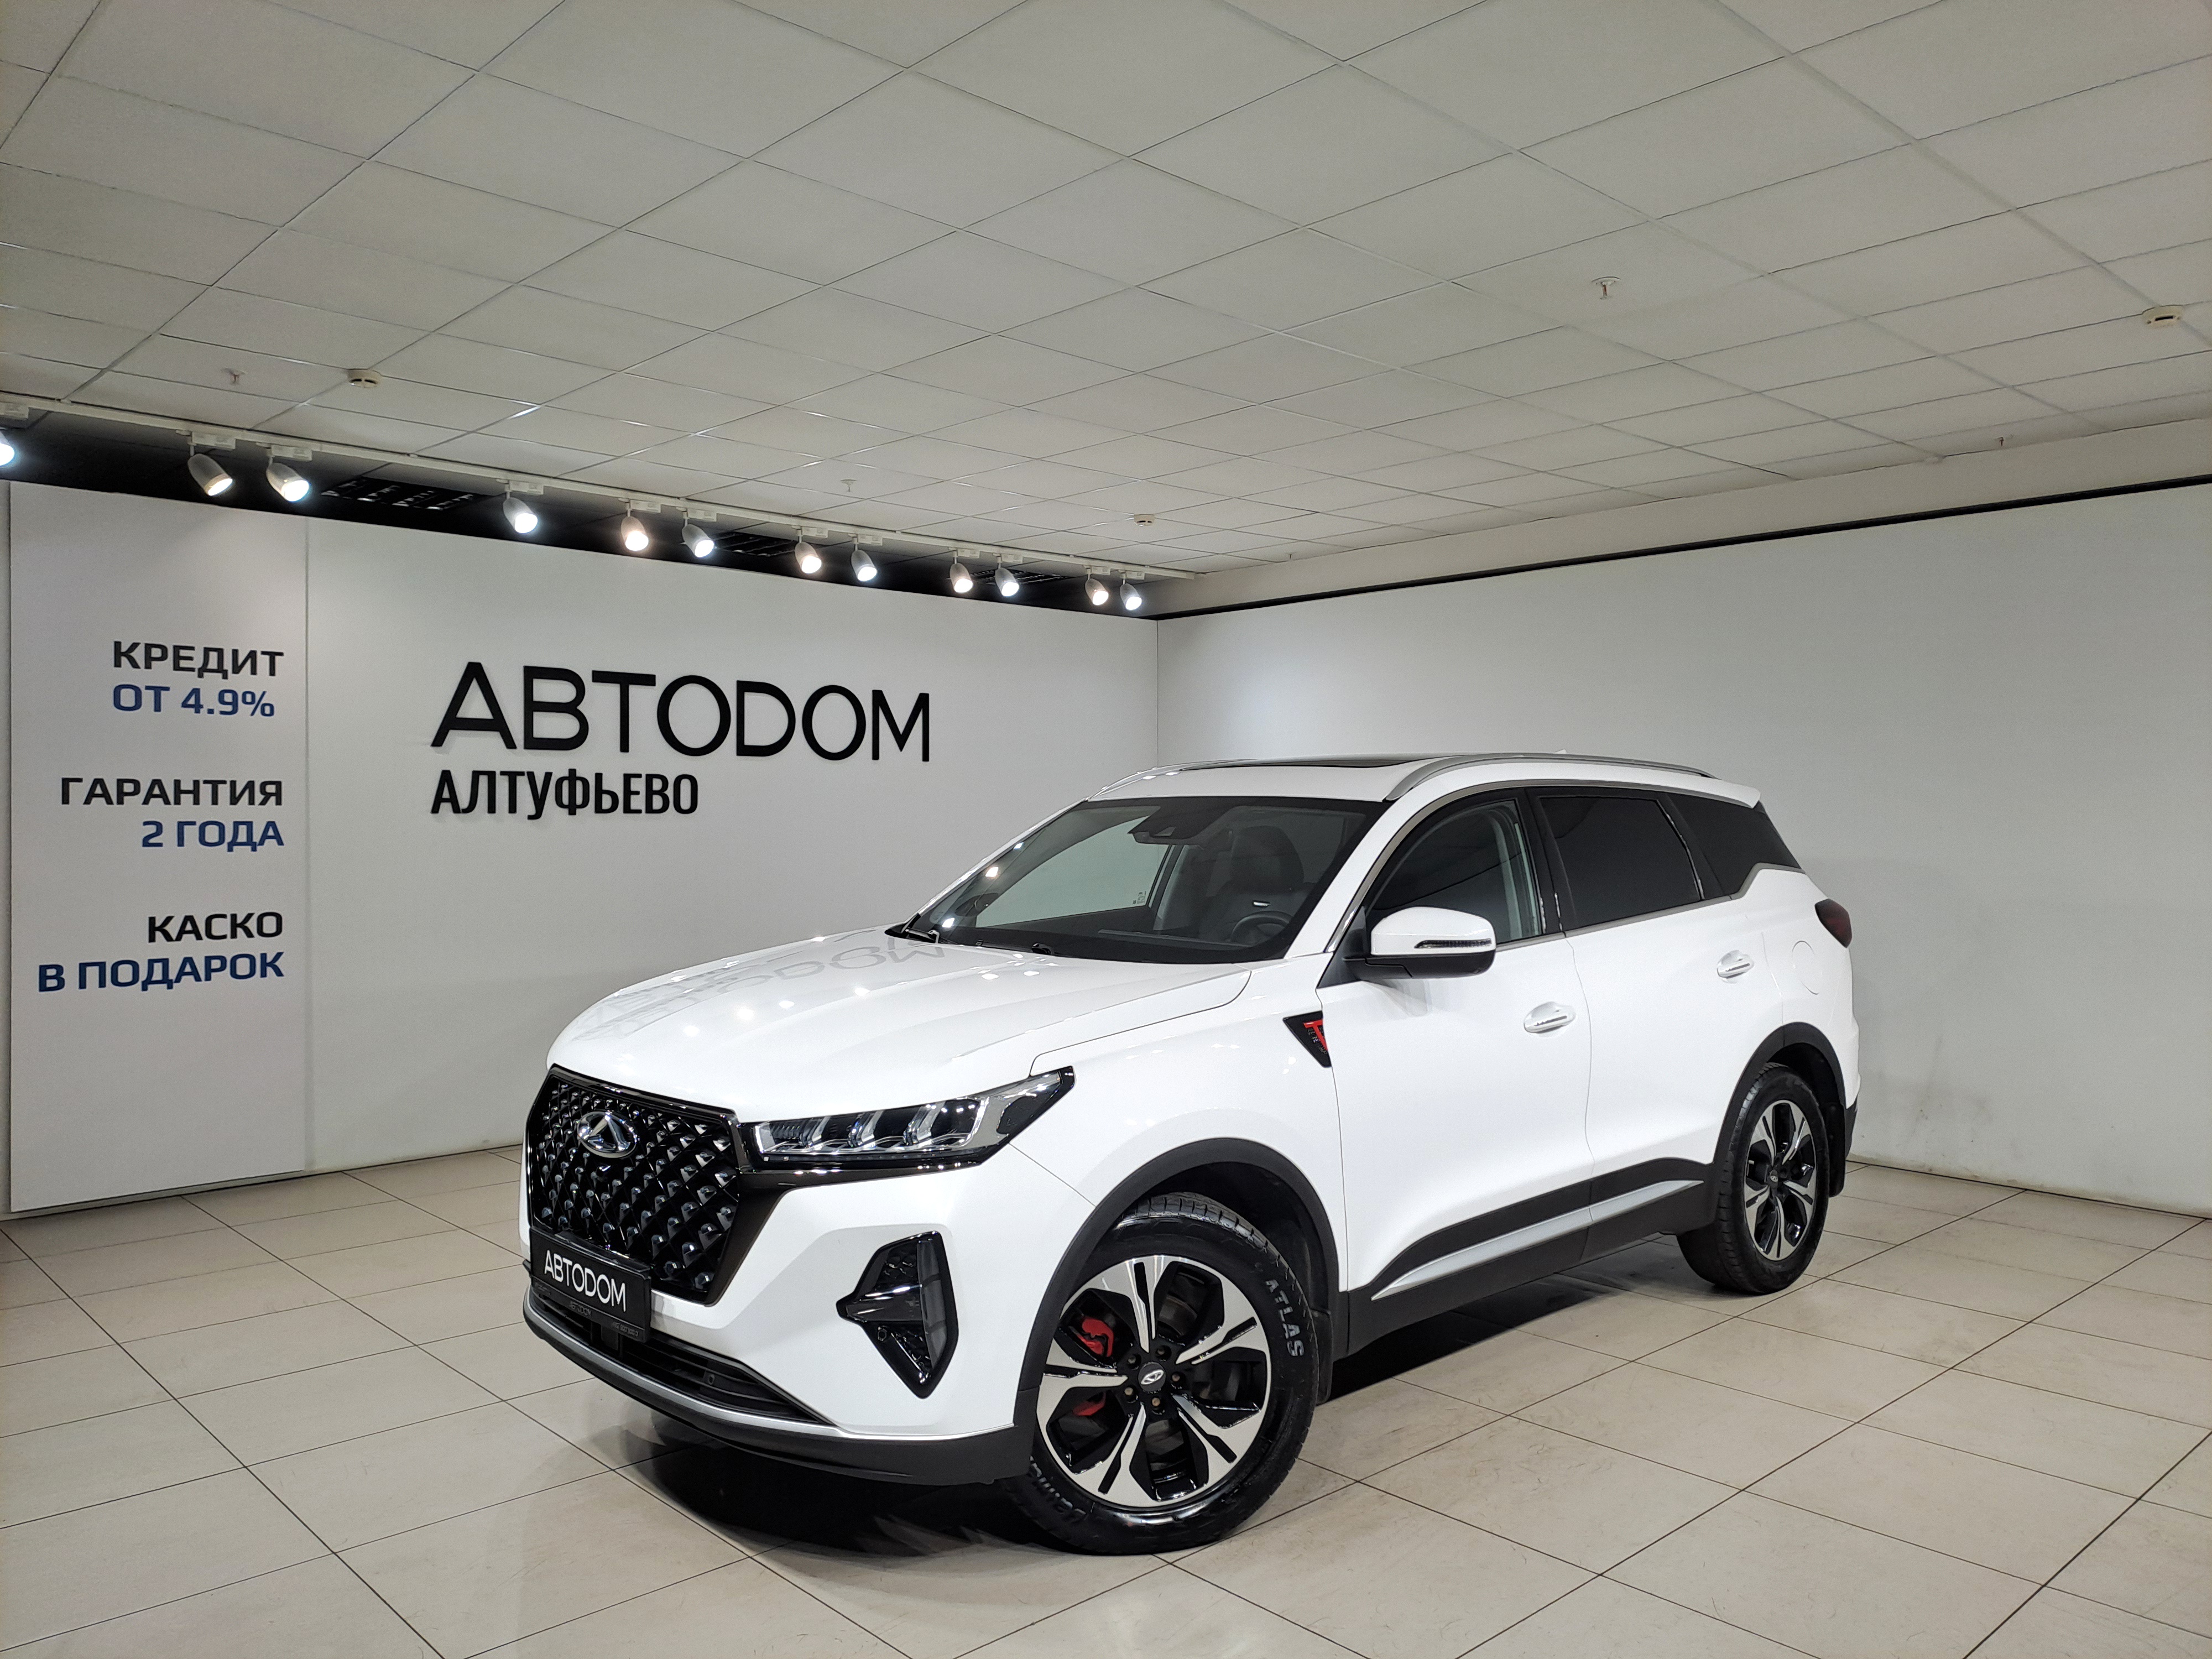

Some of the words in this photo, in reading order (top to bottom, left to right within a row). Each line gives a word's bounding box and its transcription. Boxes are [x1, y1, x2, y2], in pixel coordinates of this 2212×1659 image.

[113, 641, 284, 680] КРЕДИТ
[113, 684, 171, 713] ОТ
[181, 688, 275, 717] 4.9%
[61, 777, 283, 806] ГАРАНТИЯ
[431, 769, 699, 820] АЛТУФЬЕВО
[142, 821, 164, 848] 2
[176, 821, 285, 853] ГОДА
[148, 912, 283, 943] КАСКО
[38, 964, 66, 993] В
[79, 952, 285, 992] ПОДАРОК
[1265, 1279, 1305, 1357] ATLAS
